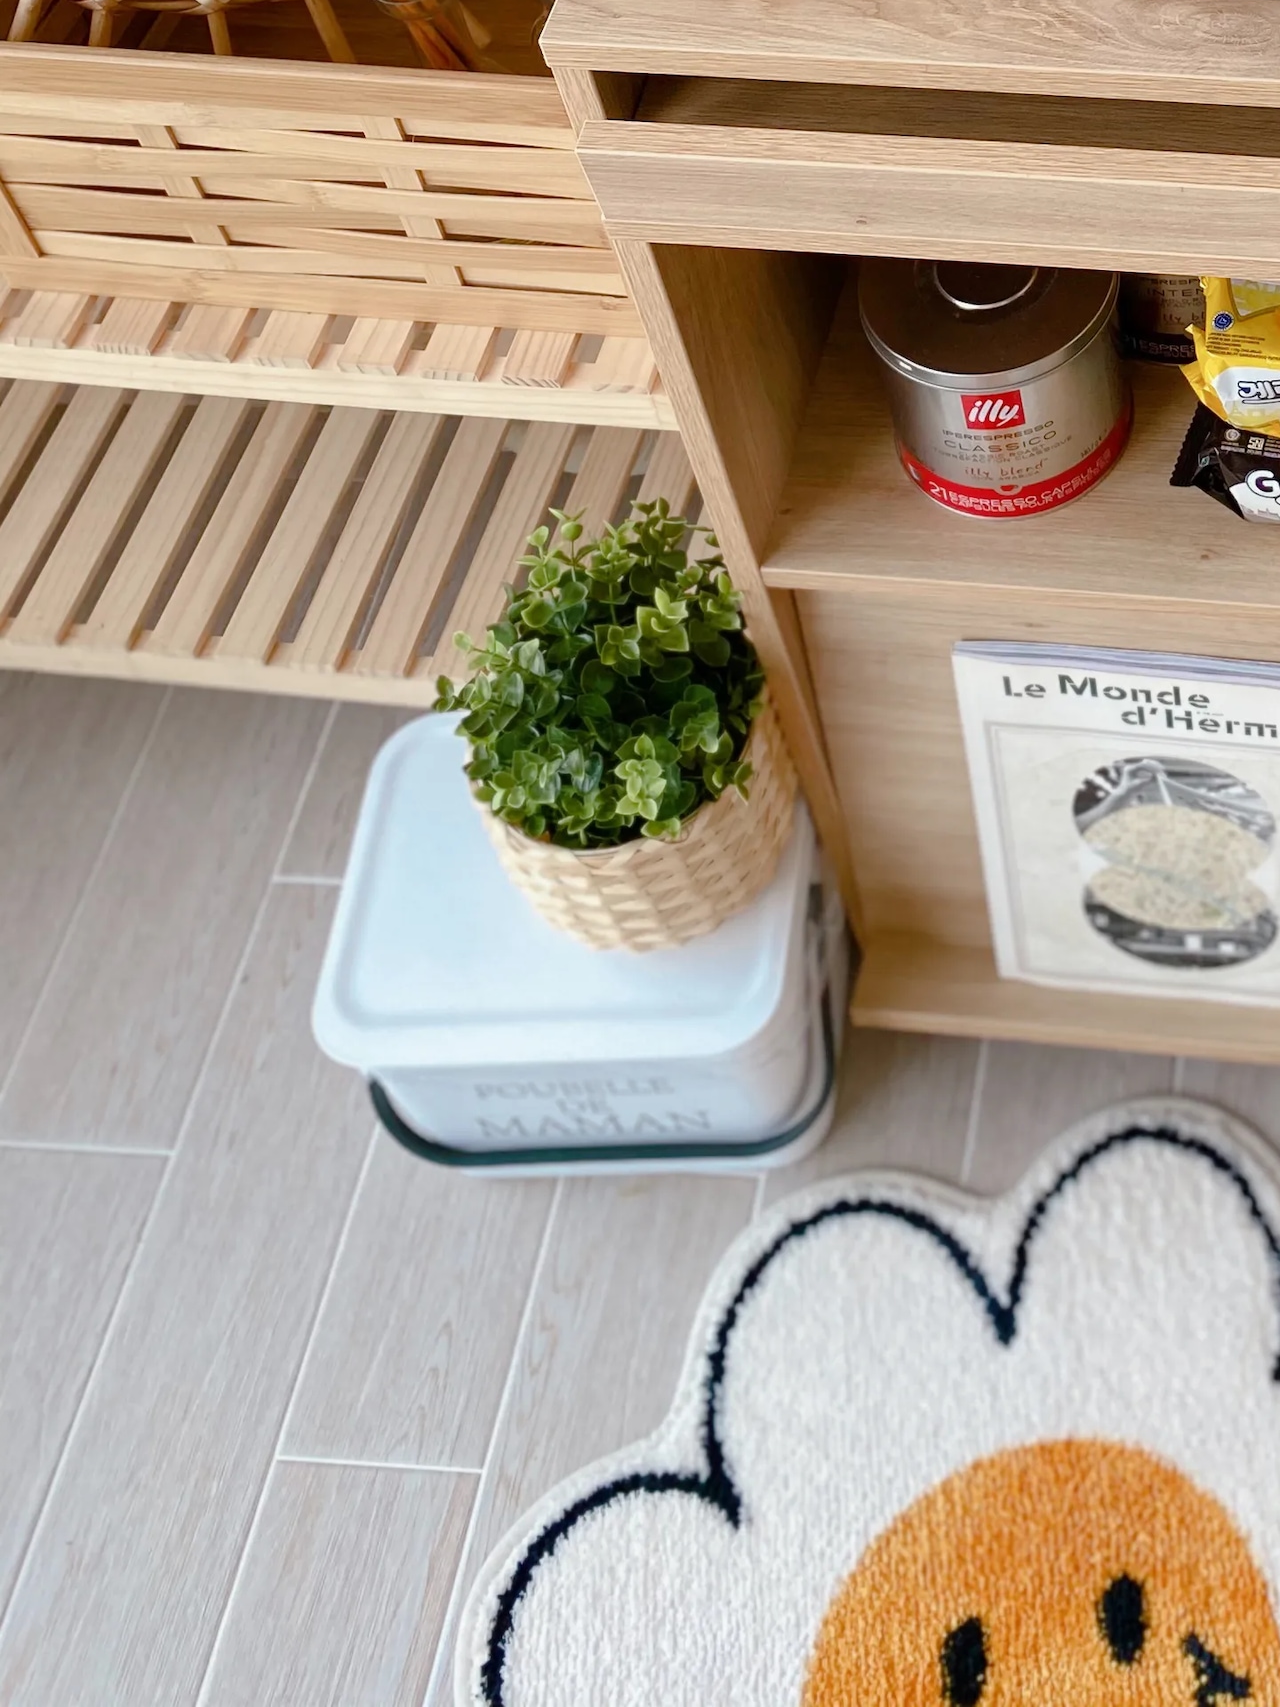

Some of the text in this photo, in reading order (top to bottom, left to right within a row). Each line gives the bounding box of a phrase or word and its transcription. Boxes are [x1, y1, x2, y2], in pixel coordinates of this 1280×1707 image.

[968, 399, 1019, 427] illy
[944, 430, 1057, 453] CLASSICO
[965, 466, 990, 478] illy
[929, 481, 948, 500] 21
[1003, 674, 1211, 709] Le Monde
[475, 1109, 713, 1139] MAMAN
